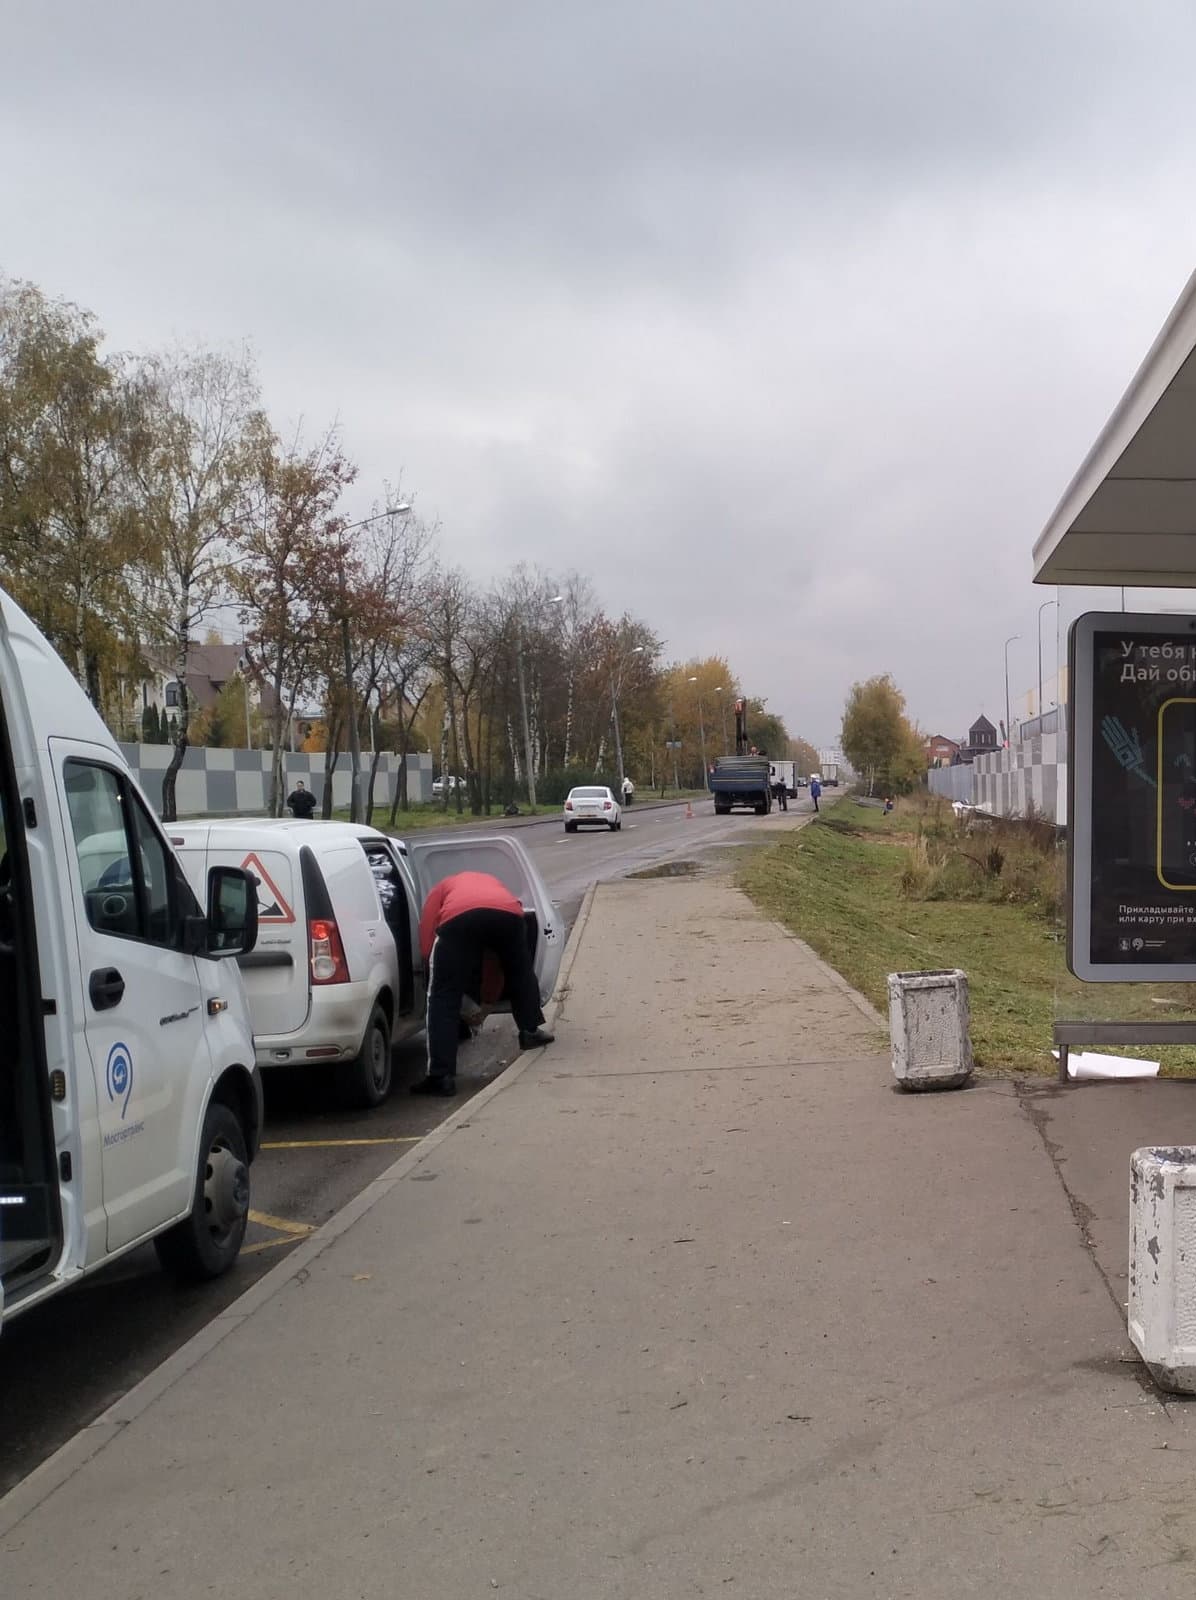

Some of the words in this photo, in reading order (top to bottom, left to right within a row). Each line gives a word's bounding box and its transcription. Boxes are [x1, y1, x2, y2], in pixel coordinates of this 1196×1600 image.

[1120, 640, 1135, 658] У
[1139, 642, 1185, 659] тебя
[1119, 663, 1161, 683] Дай
[1119, 904, 1194, 915] Прикладывайте
[1138, 916, 1165, 925] карту
[1167, 916, 1185, 924] при
